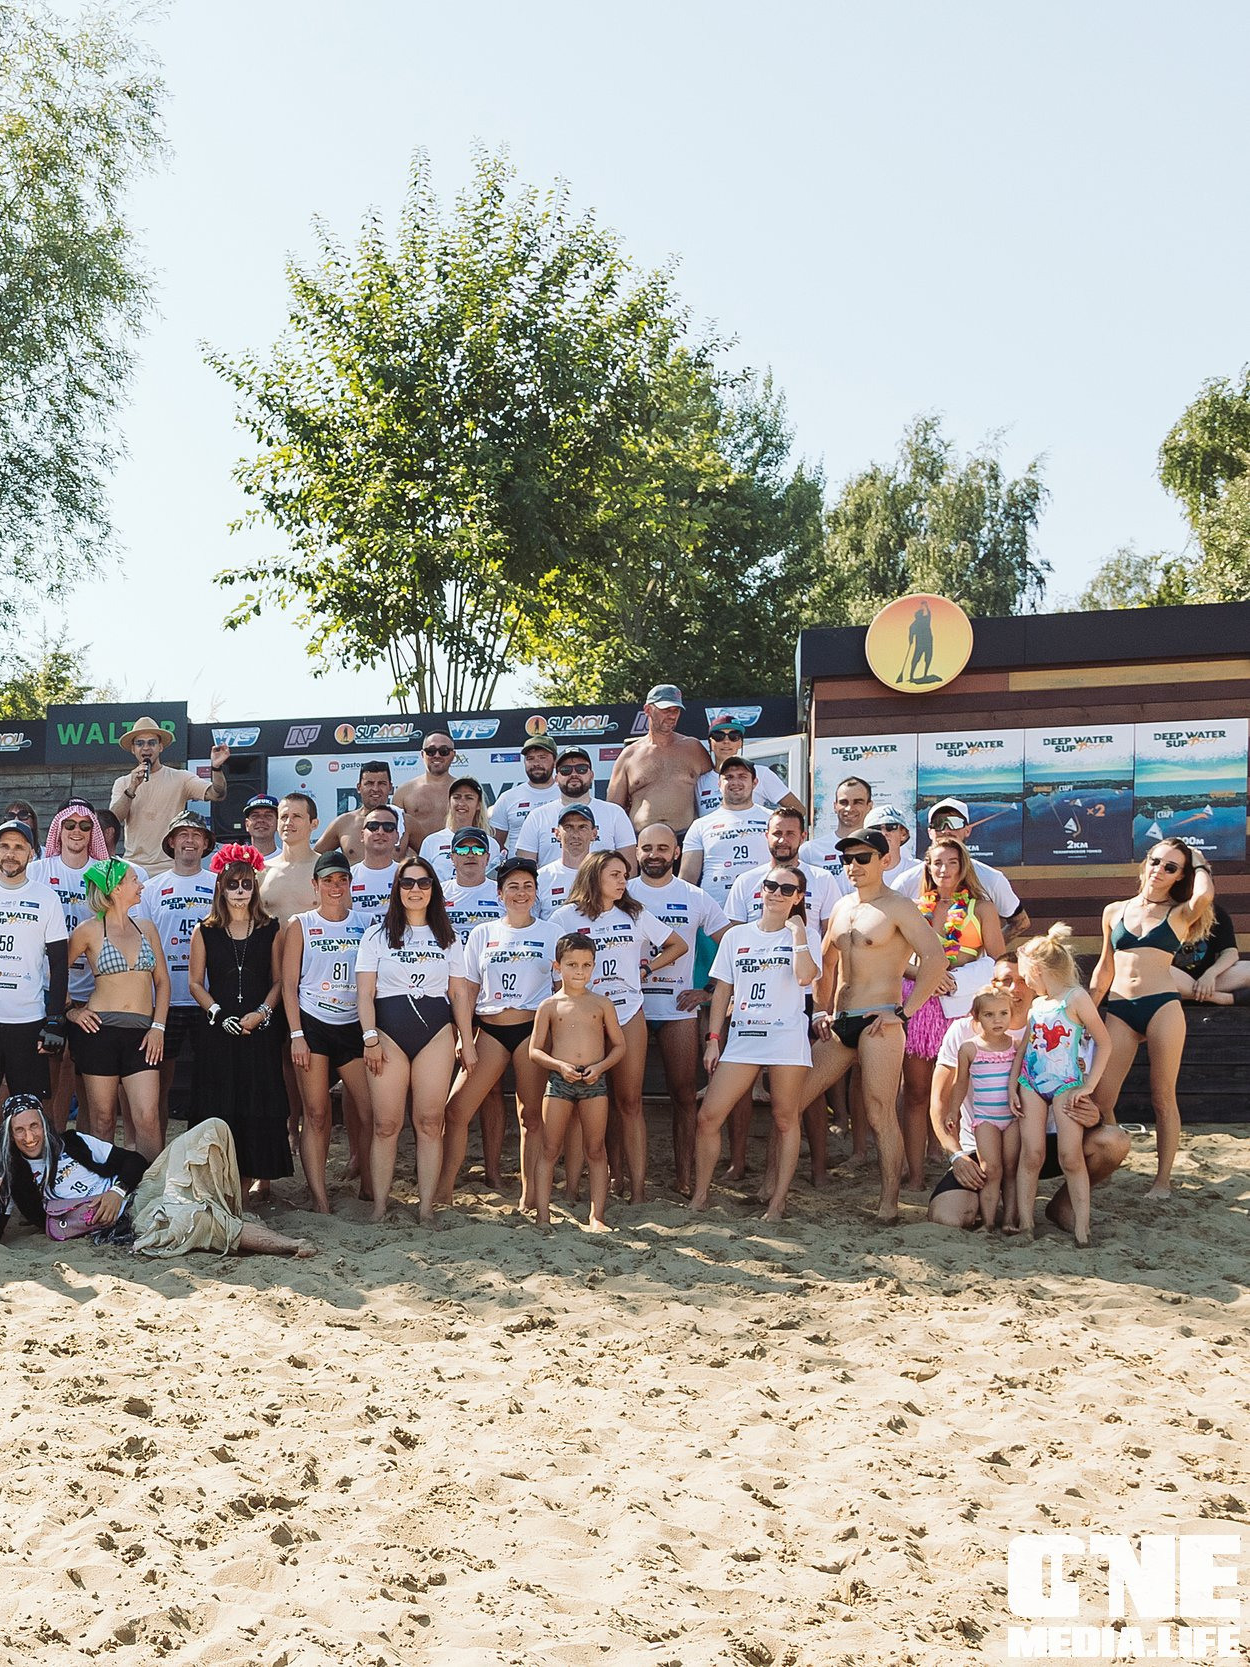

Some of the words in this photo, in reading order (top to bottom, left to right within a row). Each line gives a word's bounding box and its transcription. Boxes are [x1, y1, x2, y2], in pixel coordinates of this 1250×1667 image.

[547, 715, 610, 731] SUP4YOU
[57, 720, 176, 745] WALTR
[355, 723, 414, 739] SUP4YOU
[1153, 732, 1183, 741] DEEP
[1185, 730, 1227, 739] WATER
[936, 742, 963, 750] DEEP
[965, 740, 1004, 749] WATER
[1043, 737, 1072, 746] DEEP
[1073, 735, 1114, 744] WATER
[1165, 740, 1188, 748] SUP
[831, 746, 858, 755] DEEP
[860, 744, 897, 753] WATER
[947, 749, 968, 757] SUP
[1054, 745, 1076, 753] SUP
[842, 754, 863, 762] SUP
[701, 797, 717, 806] DEEP
[733, 845, 749, 859] 29
[161, 897, 182, 907] DEEP
[184, 896, 212, 905] WATE
[352, 895, 376, 903] DEEP
[6, 911, 38, 922] WATER
[465, 911, 500, 919] WATER
[65, 914, 78, 932] 49
[179, 918, 196, 936] 45
[310, 939, 334, 948] DEEP
[604, 935, 634, 943] WATER
[415, 951, 445, 960] WATER
[509, 950, 543, 958] WATER
[602, 959, 617, 976] 02
[735, 958, 757, 967] DEEP
[759, 957, 790, 965] WATER
[333, 962, 348, 980] 81
[410, 973, 426, 987] 22
[502, 973, 517, 990] 62
[750, 983, 766, 1000] 05
[70, 1181, 88, 1193] 19
